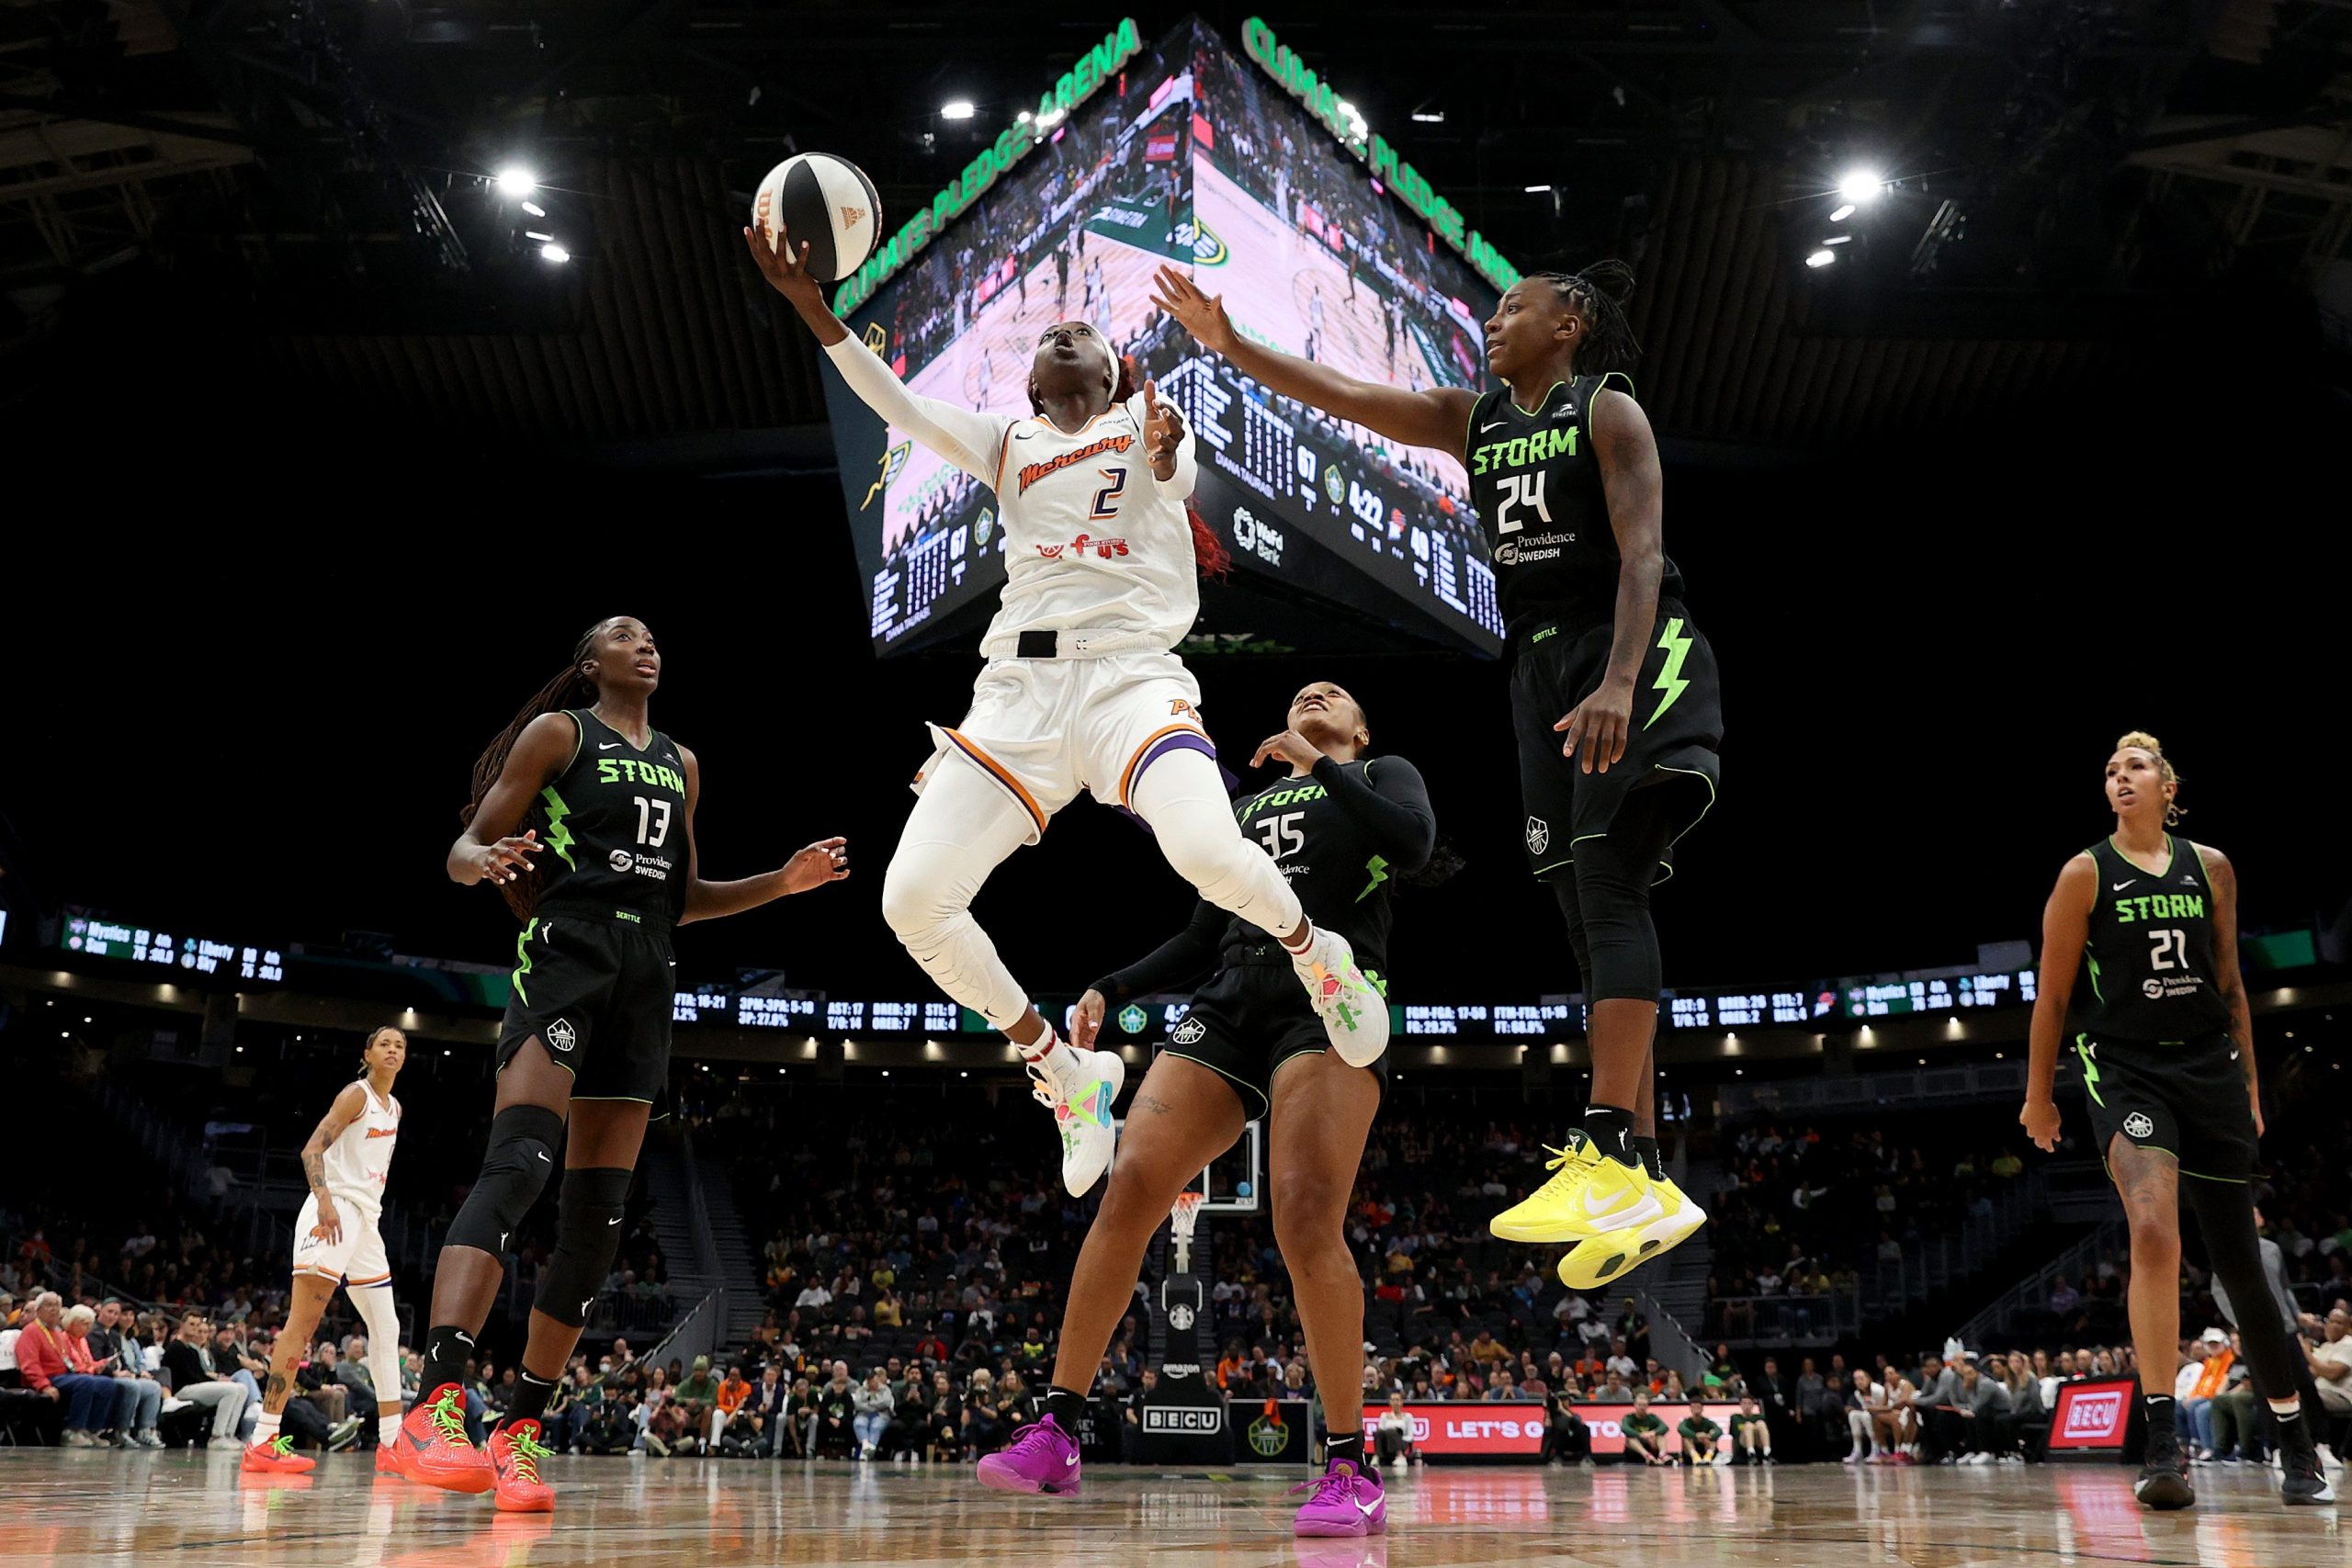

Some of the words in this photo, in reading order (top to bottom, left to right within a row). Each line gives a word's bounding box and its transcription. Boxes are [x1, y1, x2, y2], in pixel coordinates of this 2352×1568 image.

[833, 207, 933, 319] CLIMATE
[933, 118, 1035, 231] PLEDGE
[1037, 17, 1142, 135] ARENA
[1369, 132, 1467, 253] PLEDGE
[1018, 434, 1136, 499] Mercury
[1297, 445, 1317, 483] 67
[1472, 425, 1580, 476] STORM
[1089, 468, 1126, 520] 2
[1349, 480, 1384, 532] 4:22
[1497, 469, 1553, 535] 24
[950, 525, 968, 560] 67
[1517, 532, 1576, 547] Providence
[1518, 548, 1560, 563] SWEDISH
[597, 759, 685, 800] STORM
[634, 796, 672, 848] 13
[1256, 811, 1305, 861] 35
[616, 910, 641, 924] SEATTLE
[2115, 895, 2204, 923] STORM
[2148, 929, 2189, 971] 21
[1162, 1363, 1200, 1374] amazon
[1149, 1412, 1215, 1428] BECU
[1446, 1421, 1520, 1438] LET'S
[2070, 1403, 2117, 1427] BECU
